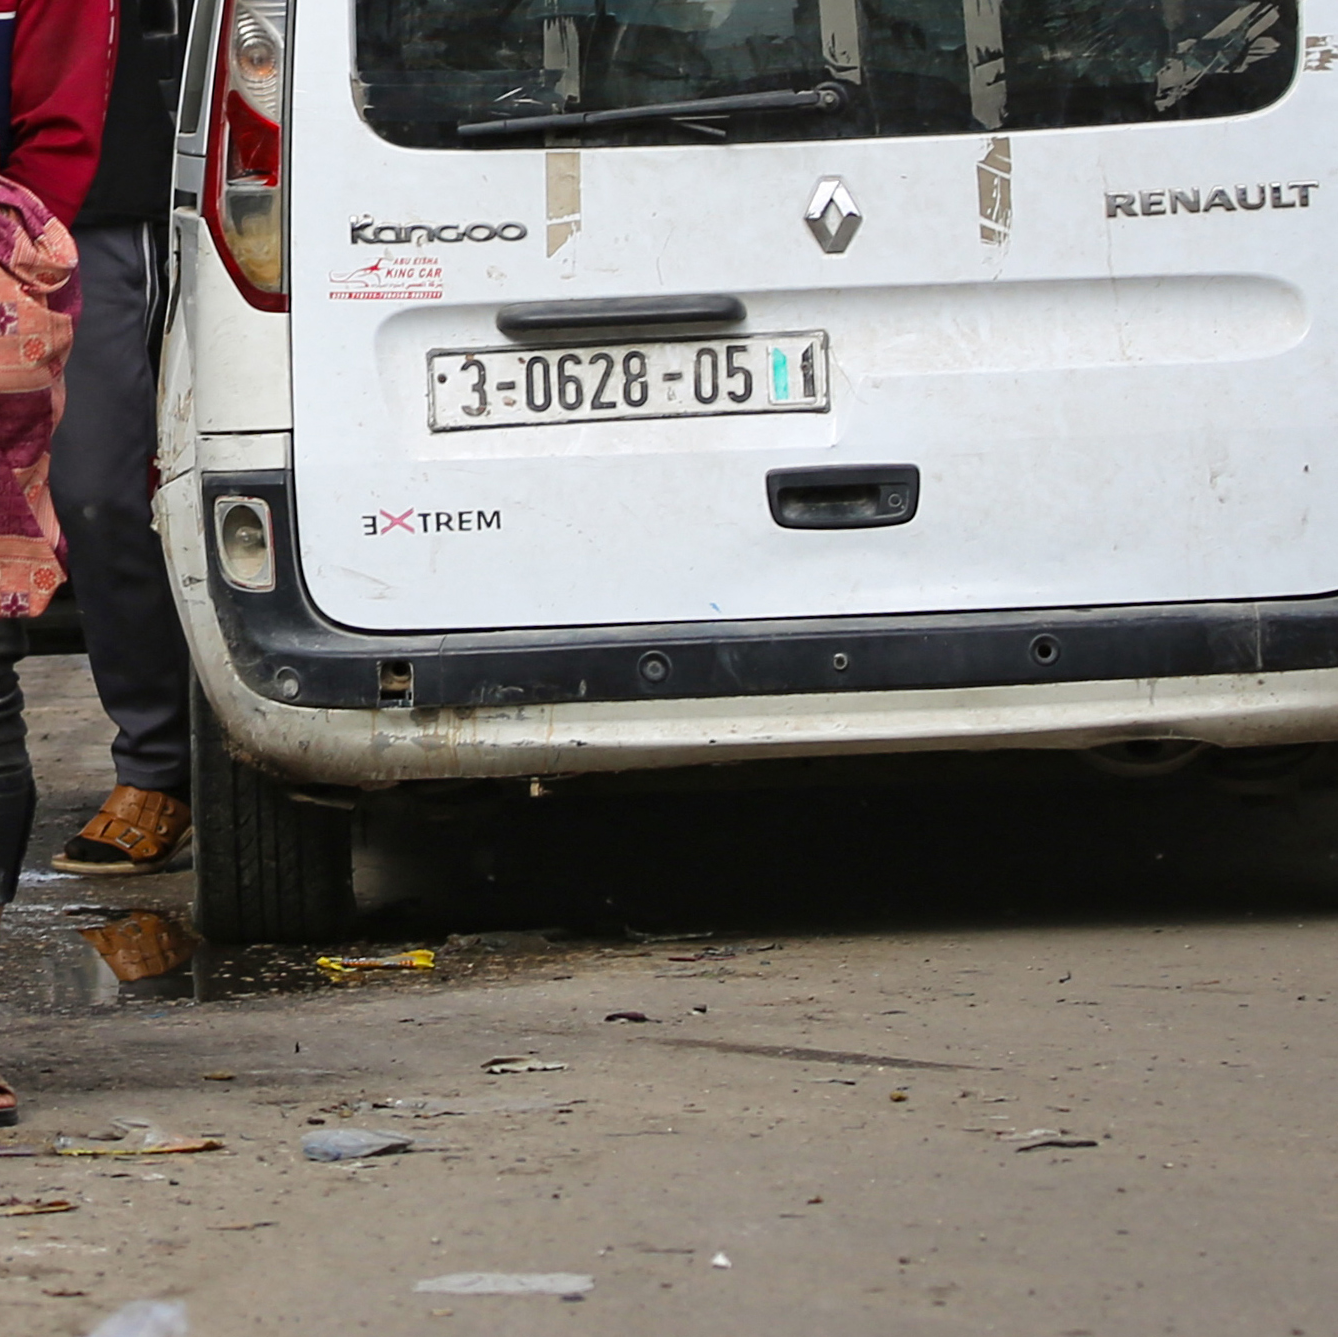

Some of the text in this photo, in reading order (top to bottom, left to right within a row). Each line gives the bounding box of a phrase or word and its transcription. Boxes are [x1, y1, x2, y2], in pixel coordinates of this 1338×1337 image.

[1104, 180, 1319, 219] RENAULT
[385, 267, 443, 279] KING CAR
[460, 345, 752, 417] 3-0628-05
